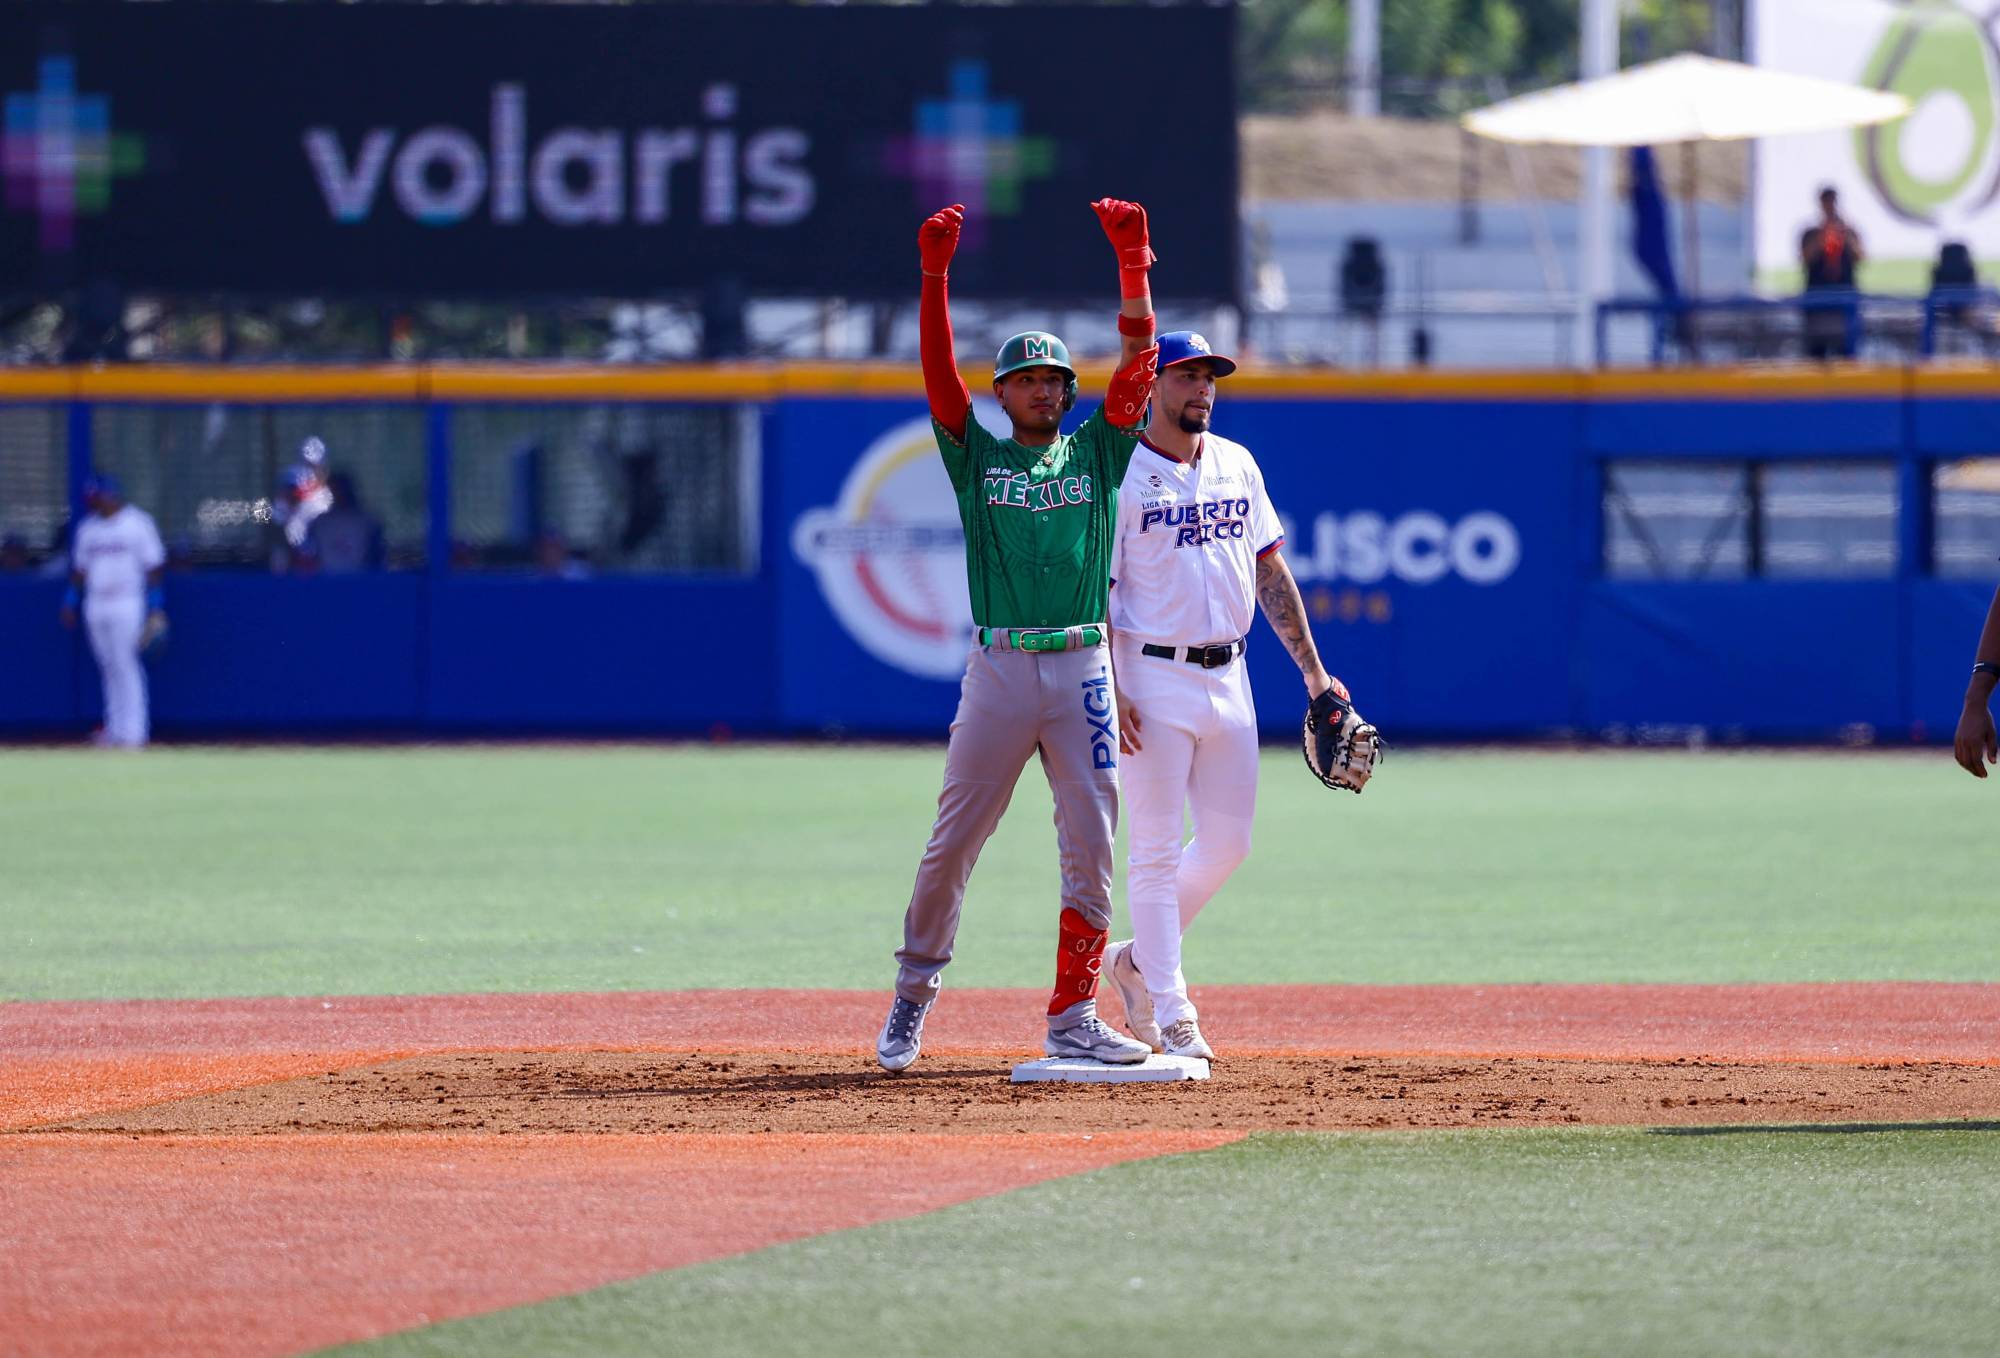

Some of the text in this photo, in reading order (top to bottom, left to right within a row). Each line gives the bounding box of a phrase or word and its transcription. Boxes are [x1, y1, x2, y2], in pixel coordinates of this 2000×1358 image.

[303, 83, 816, 224] volaris
[1024, 338, 1052, 359] M
[986, 467, 1001, 475] LIGA
[984, 472, 1094, 511] MÉXICO
[1142, 501, 1160, 510] LIGA
[1140, 498, 1249, 534] PUERTO
[1174, 521, 1245, 549] RICO
